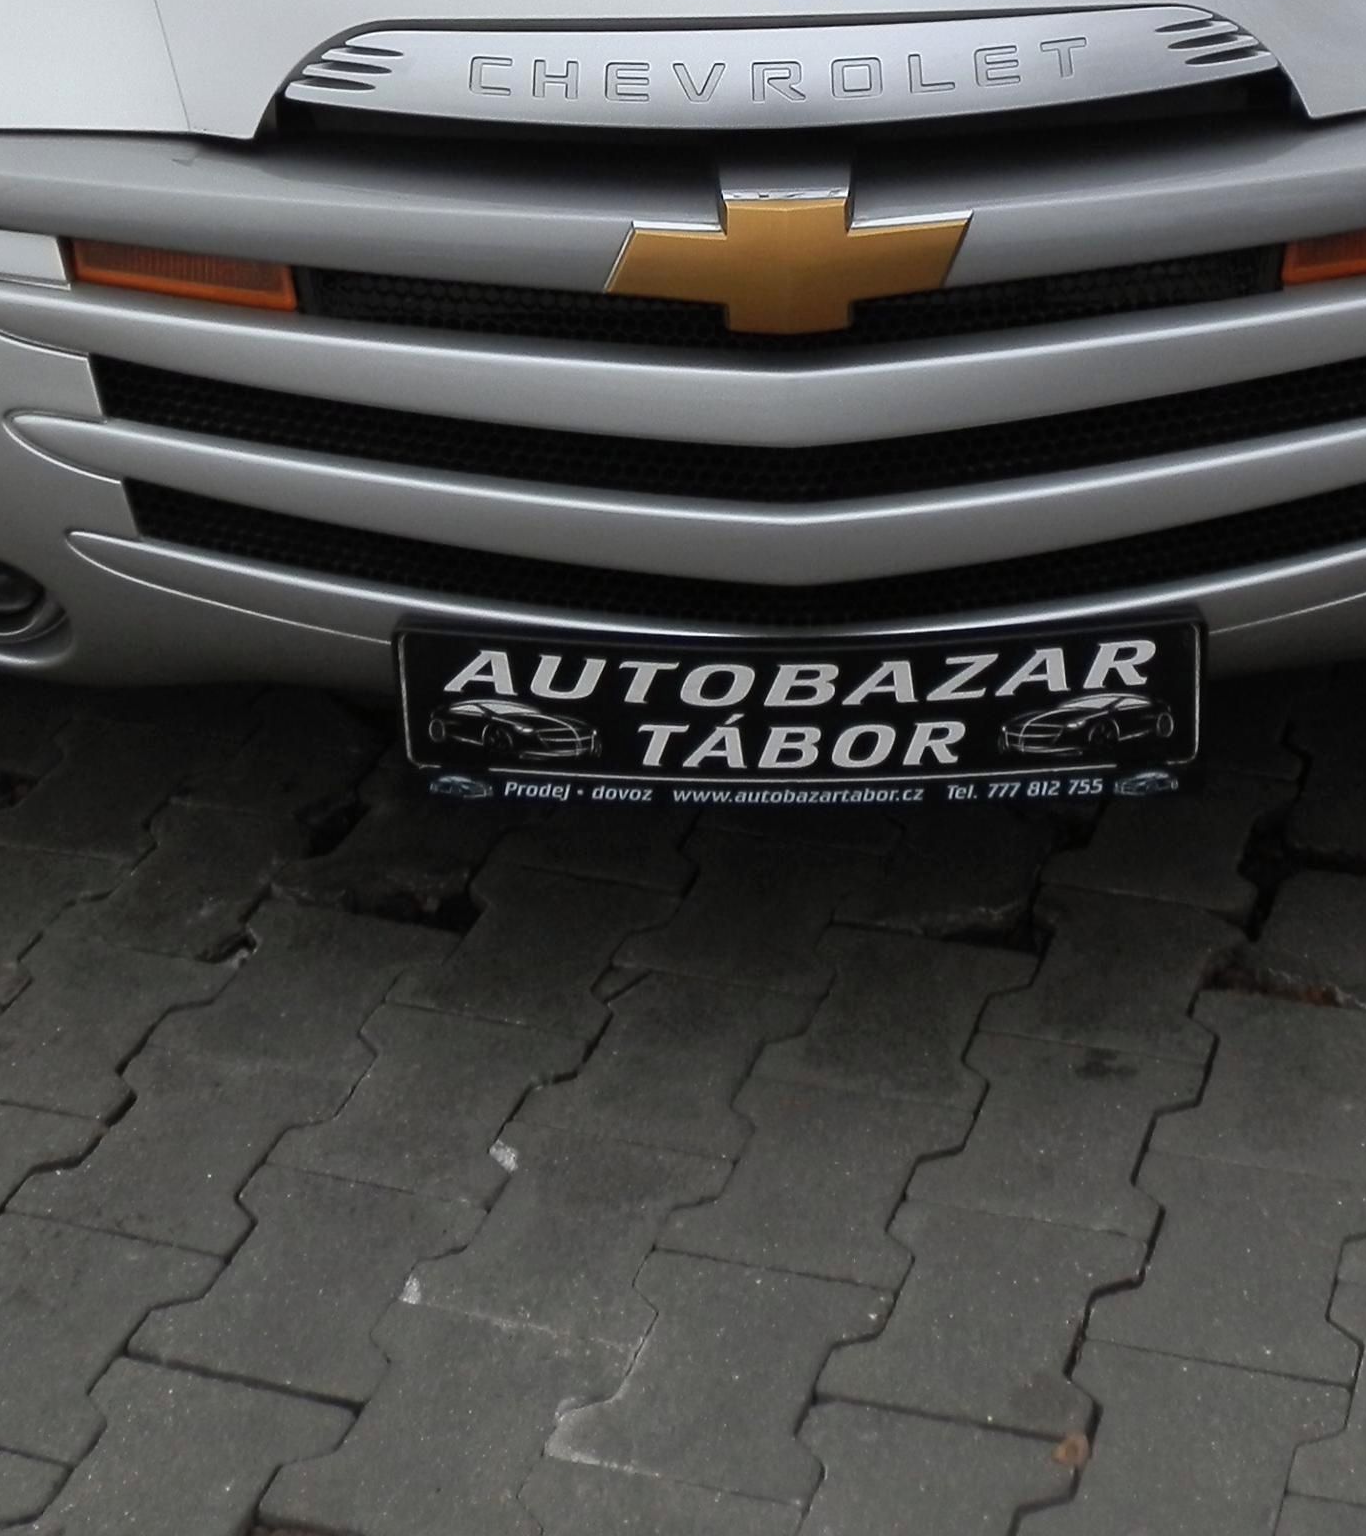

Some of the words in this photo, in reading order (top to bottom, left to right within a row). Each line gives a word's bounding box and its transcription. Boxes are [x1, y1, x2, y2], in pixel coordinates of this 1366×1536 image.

[468, 36, 1088, 104] CHEVROLET
[443, 638, 1157, 708] AUTOBAZAR
[637, 713, 967, 769] TÁBOR
[503, 781, 572, 802] Prodej
[591, 785, 653, 802] dovoz
[672, 786, 925, 804] www.autobazartabor.cz
[946, 784, 978, 801] Tel.
[987, 781, 1022, 800] 777
[1026, 780, 1061, 798] 812
[1067, 778, 1104, 796] 755
